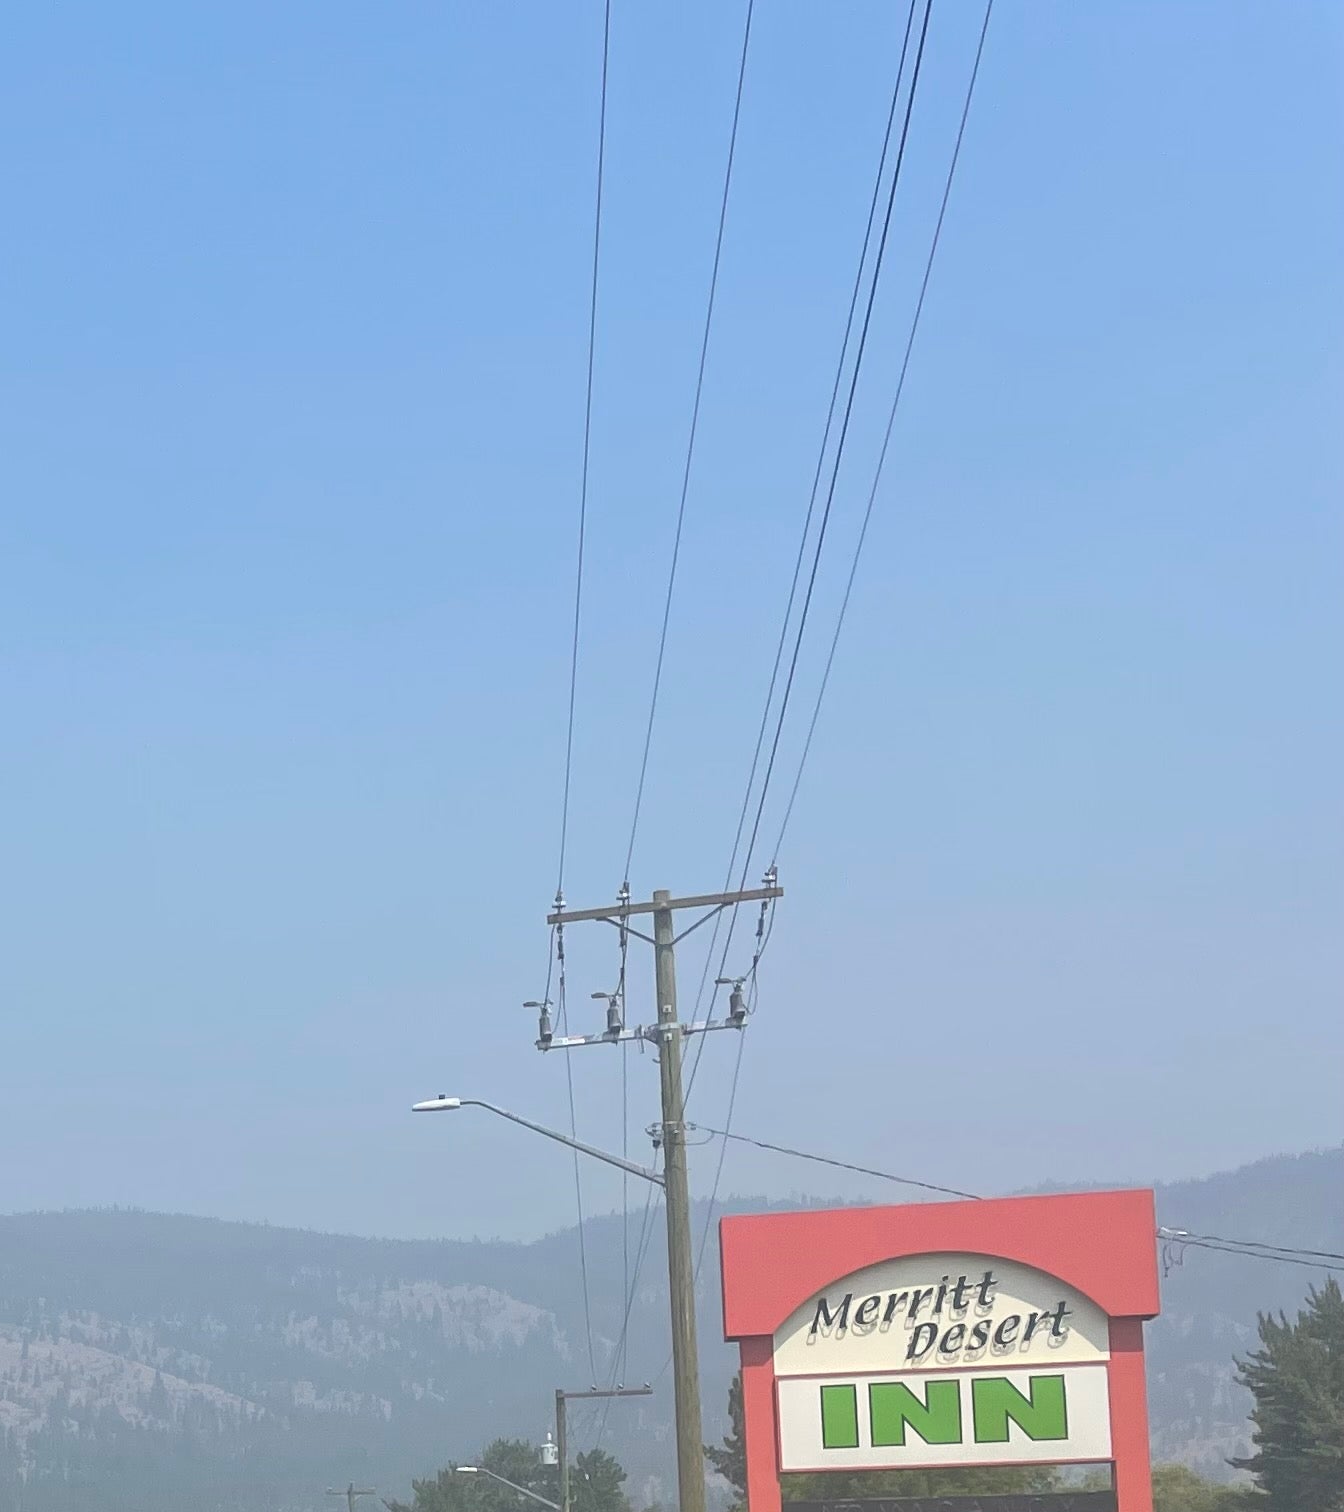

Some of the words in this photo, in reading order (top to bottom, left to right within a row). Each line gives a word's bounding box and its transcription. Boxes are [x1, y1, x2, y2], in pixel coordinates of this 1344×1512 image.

[811, 1270, 999, 1334] Merritt
[906, 1300, 1072, 1359] Desert
[820, 1374, 1069, 1449] INN
